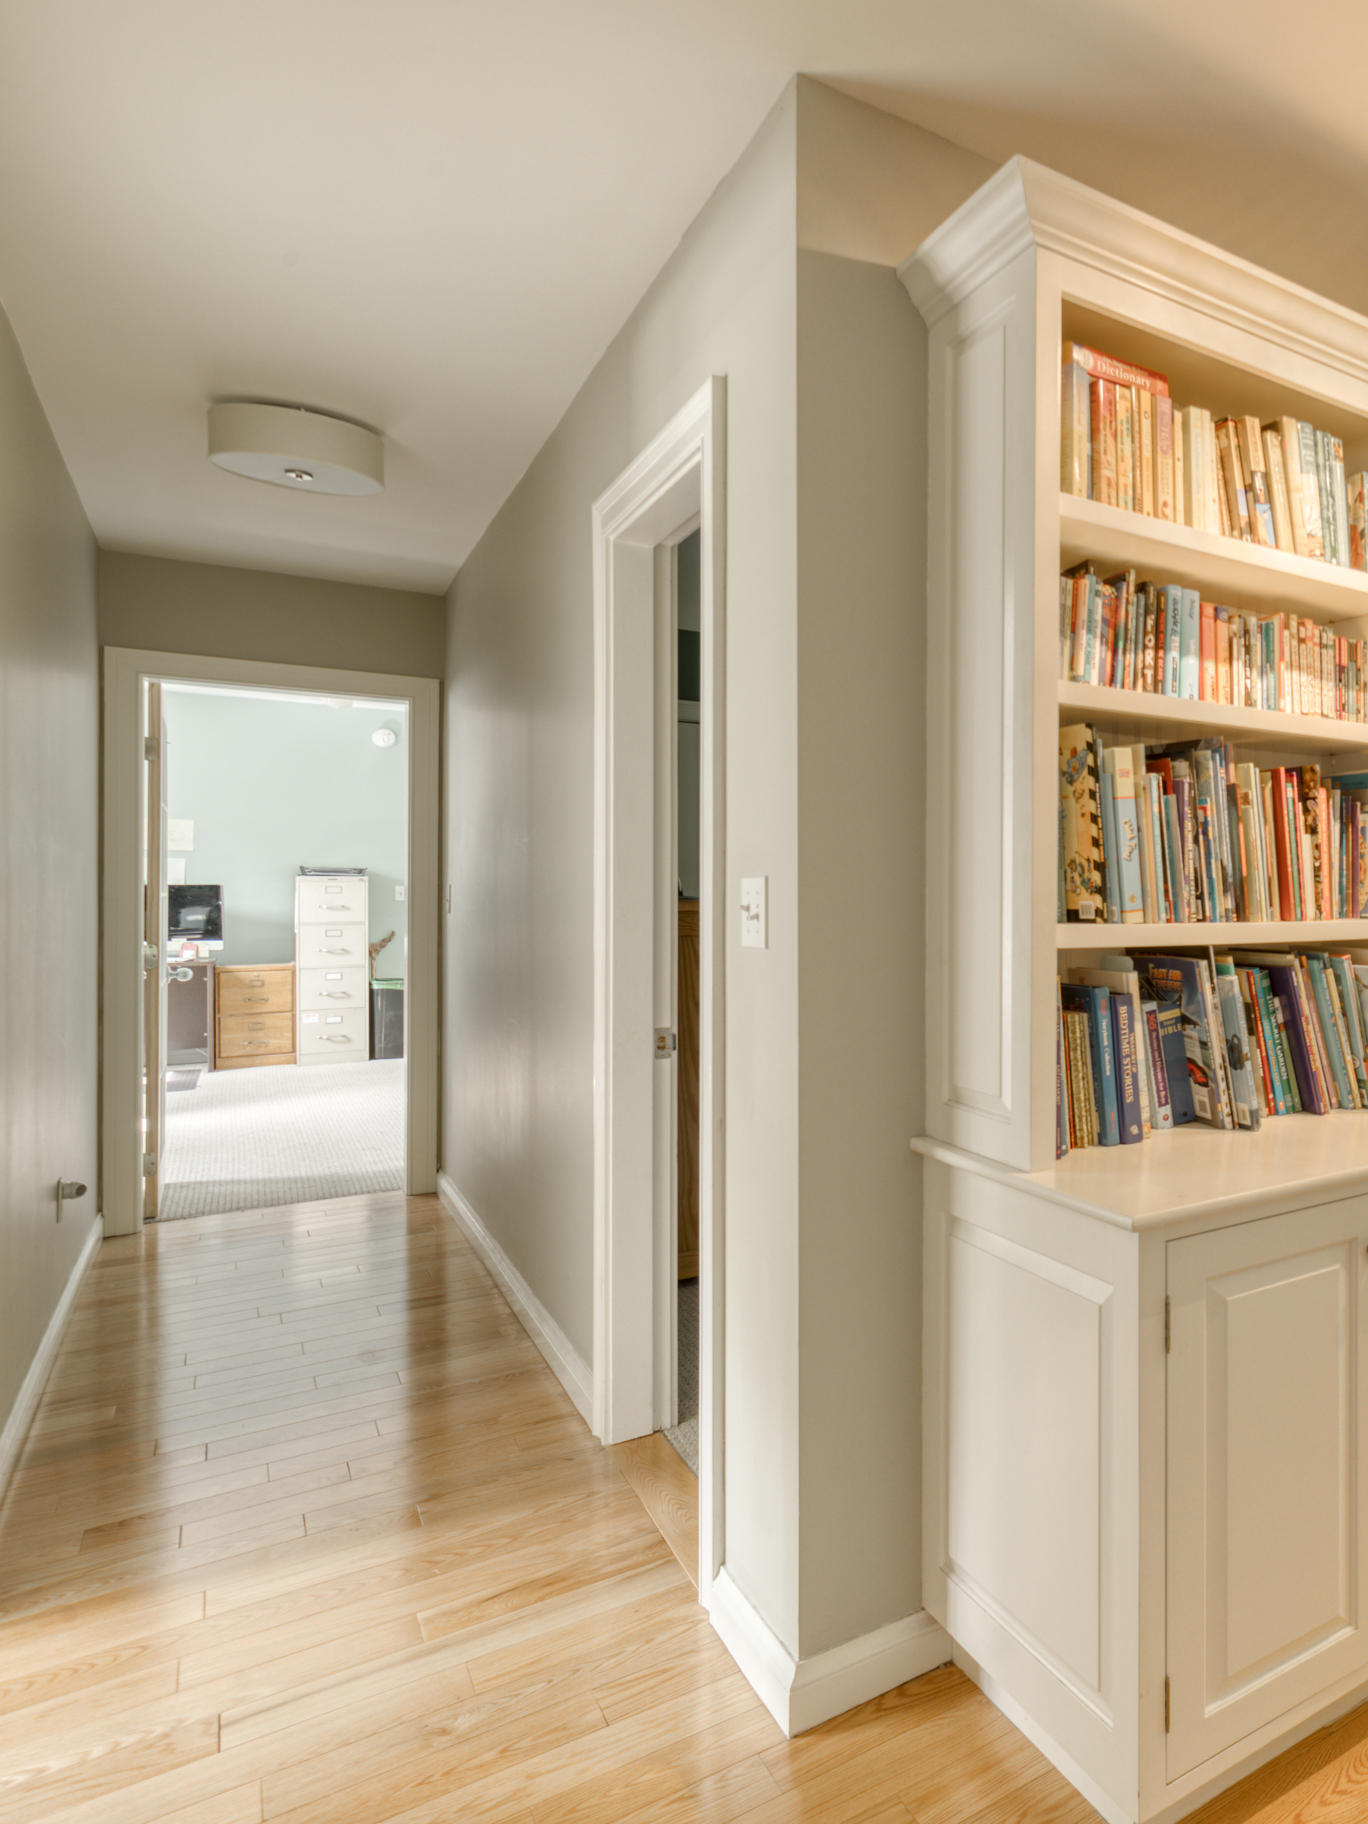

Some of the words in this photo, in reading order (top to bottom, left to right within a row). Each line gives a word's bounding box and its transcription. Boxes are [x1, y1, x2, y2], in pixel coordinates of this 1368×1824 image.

[1097, 359, 1151, 389] Dictionary
[1119, 1005, 1130, 1057] BEDTIME
[1270, 1014, 1281, 1043] SECRET
[1276, 1045, 1288, 1080] GARDEN
[1123, 1058, 1134, 1104] STORIES
